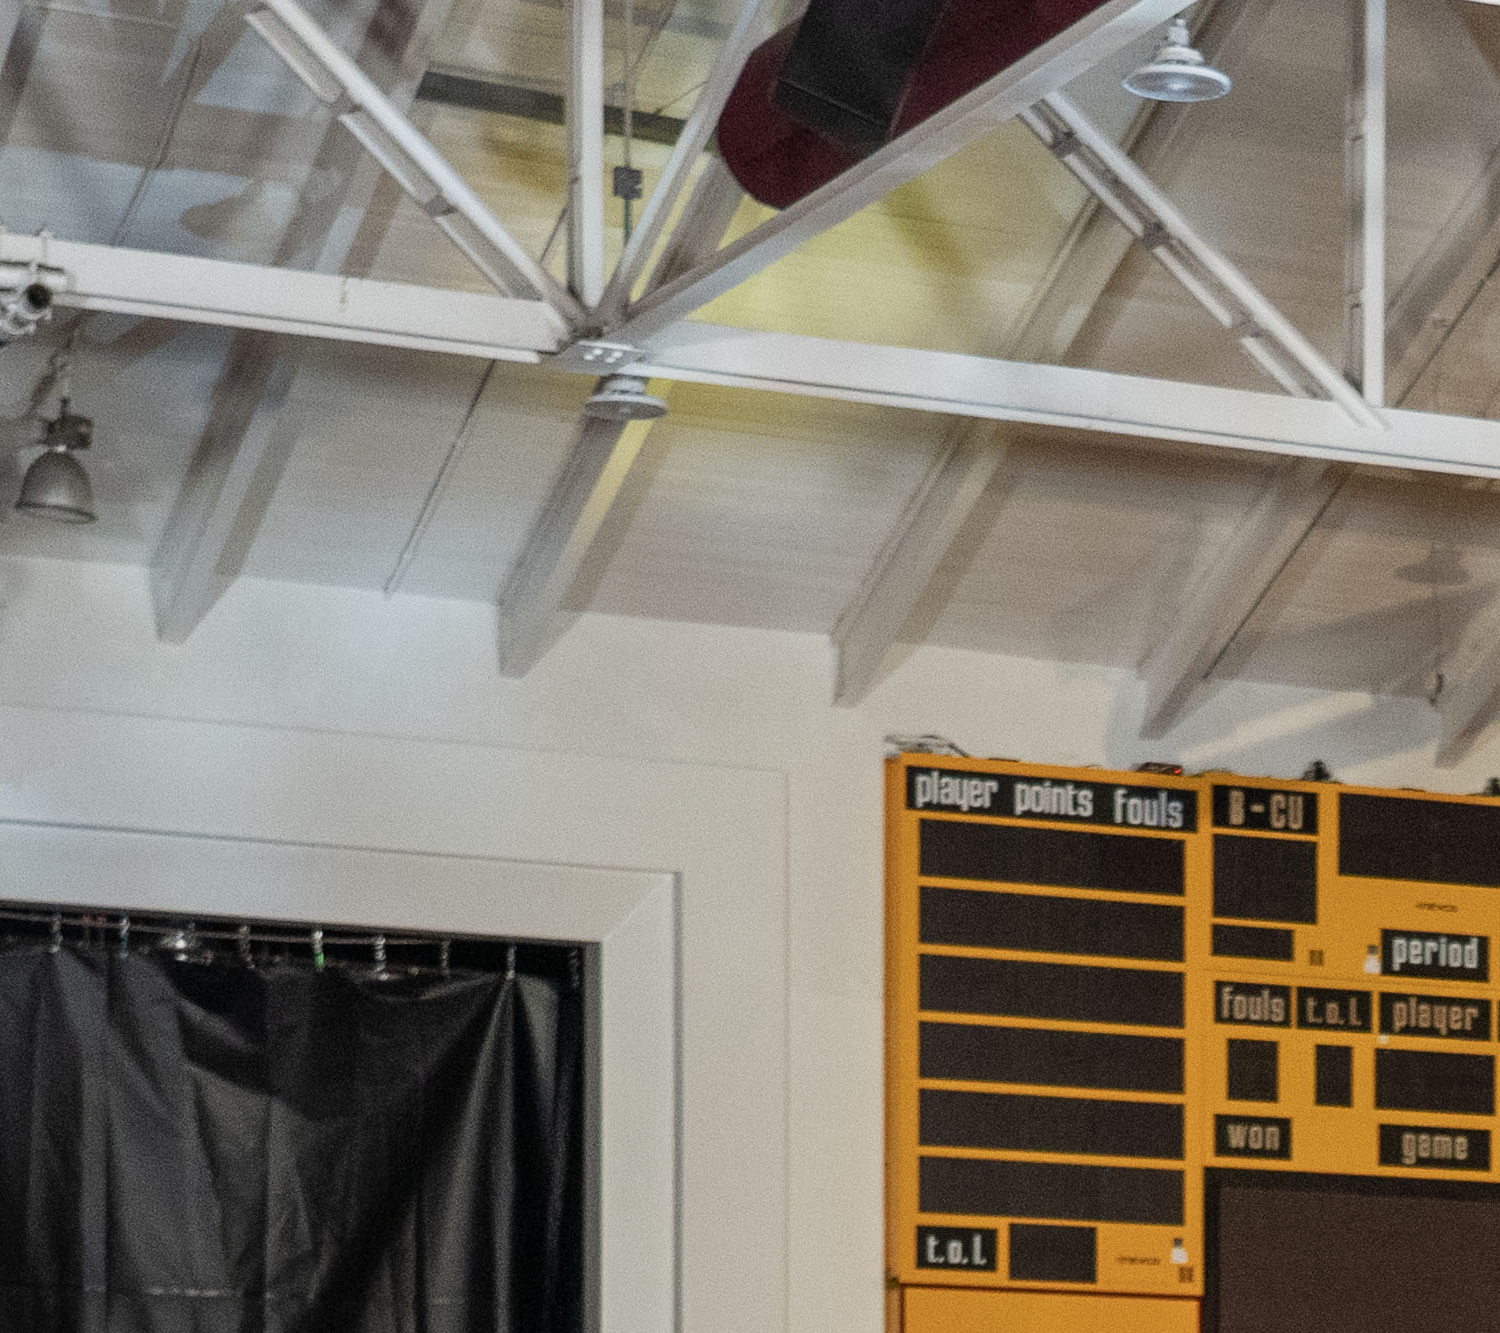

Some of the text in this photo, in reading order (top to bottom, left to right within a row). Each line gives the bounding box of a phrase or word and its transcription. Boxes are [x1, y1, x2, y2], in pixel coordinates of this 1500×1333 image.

[914, 770, 1184, 828] player points fouls
[1391, 935, 1479, 970] period
[1220, 986, 1286, 1023] fouls
[1393, 1000, 1479, 1034] player
[1226, 1123, 1281, 1152] won
[1400, 1131, 1469, 1165] game
